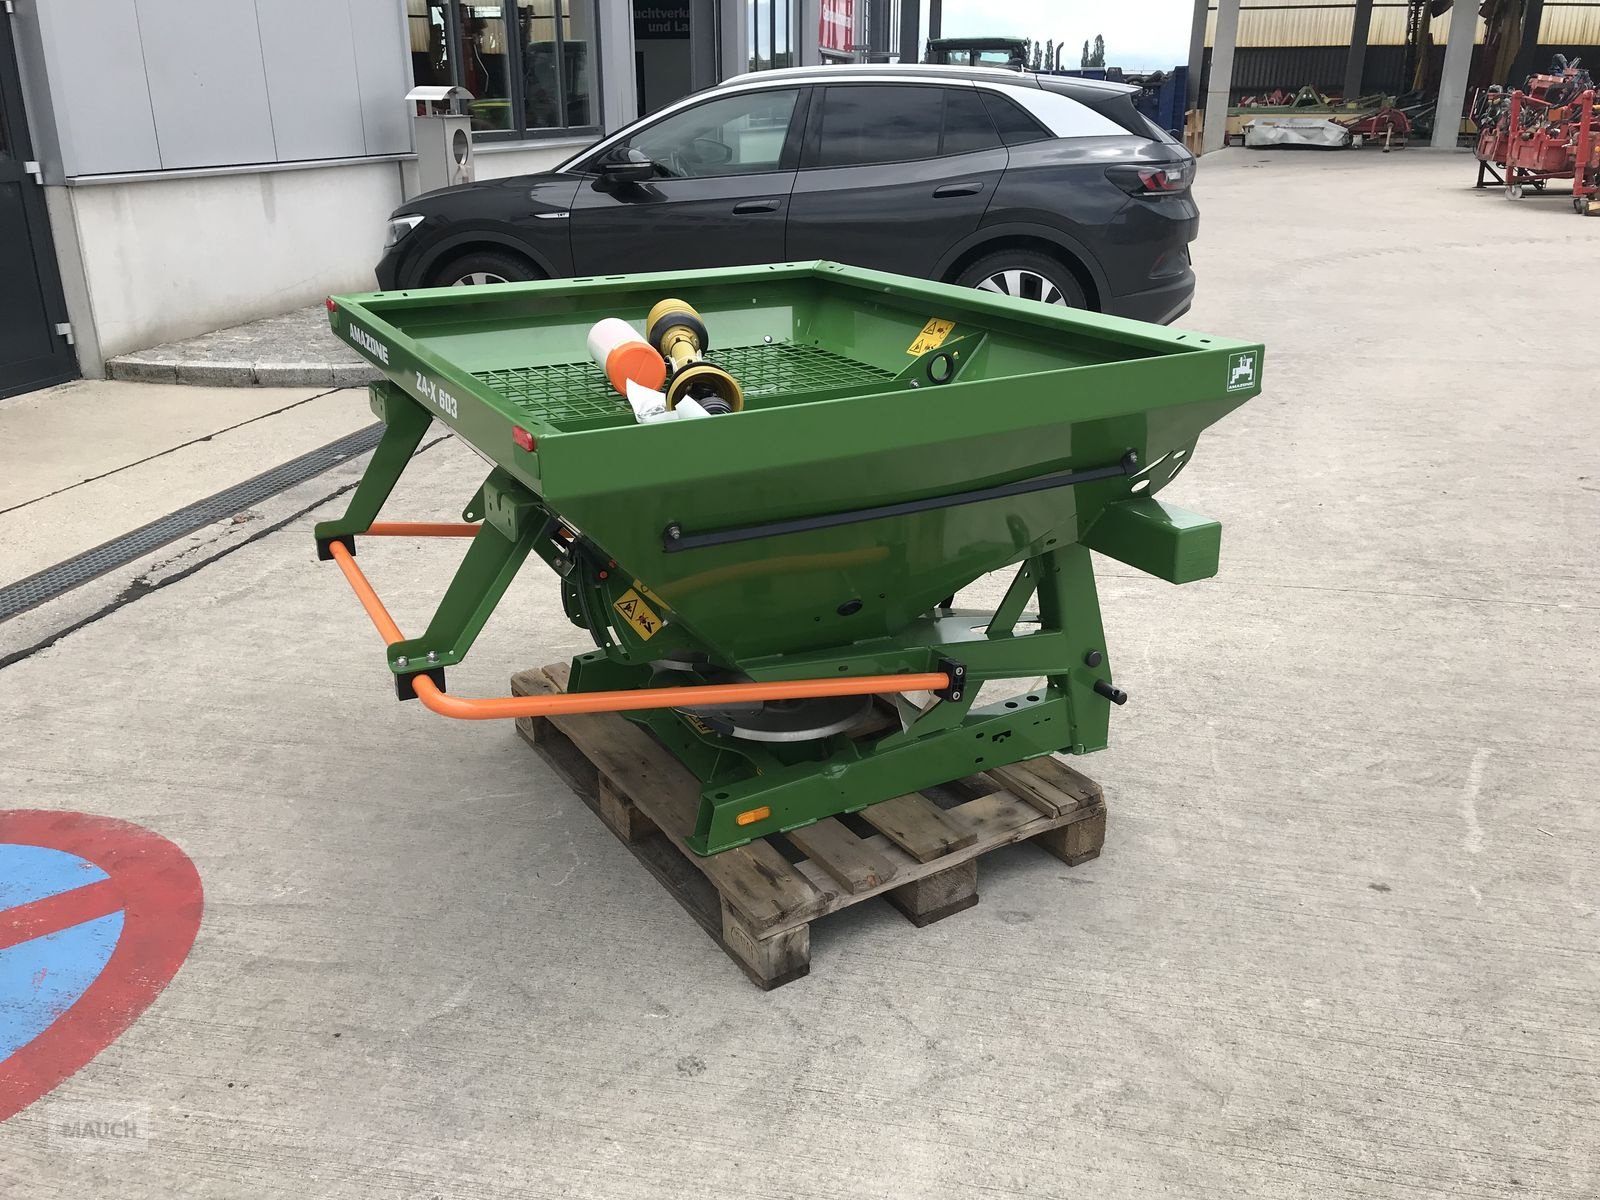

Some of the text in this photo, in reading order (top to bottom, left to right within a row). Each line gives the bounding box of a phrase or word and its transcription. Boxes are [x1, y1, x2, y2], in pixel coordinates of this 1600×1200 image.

[648, 21, 671, 32] und
[349, 322, 389, 365] AMAZONE
[415, 370, 458, 419] ZA-X 603
